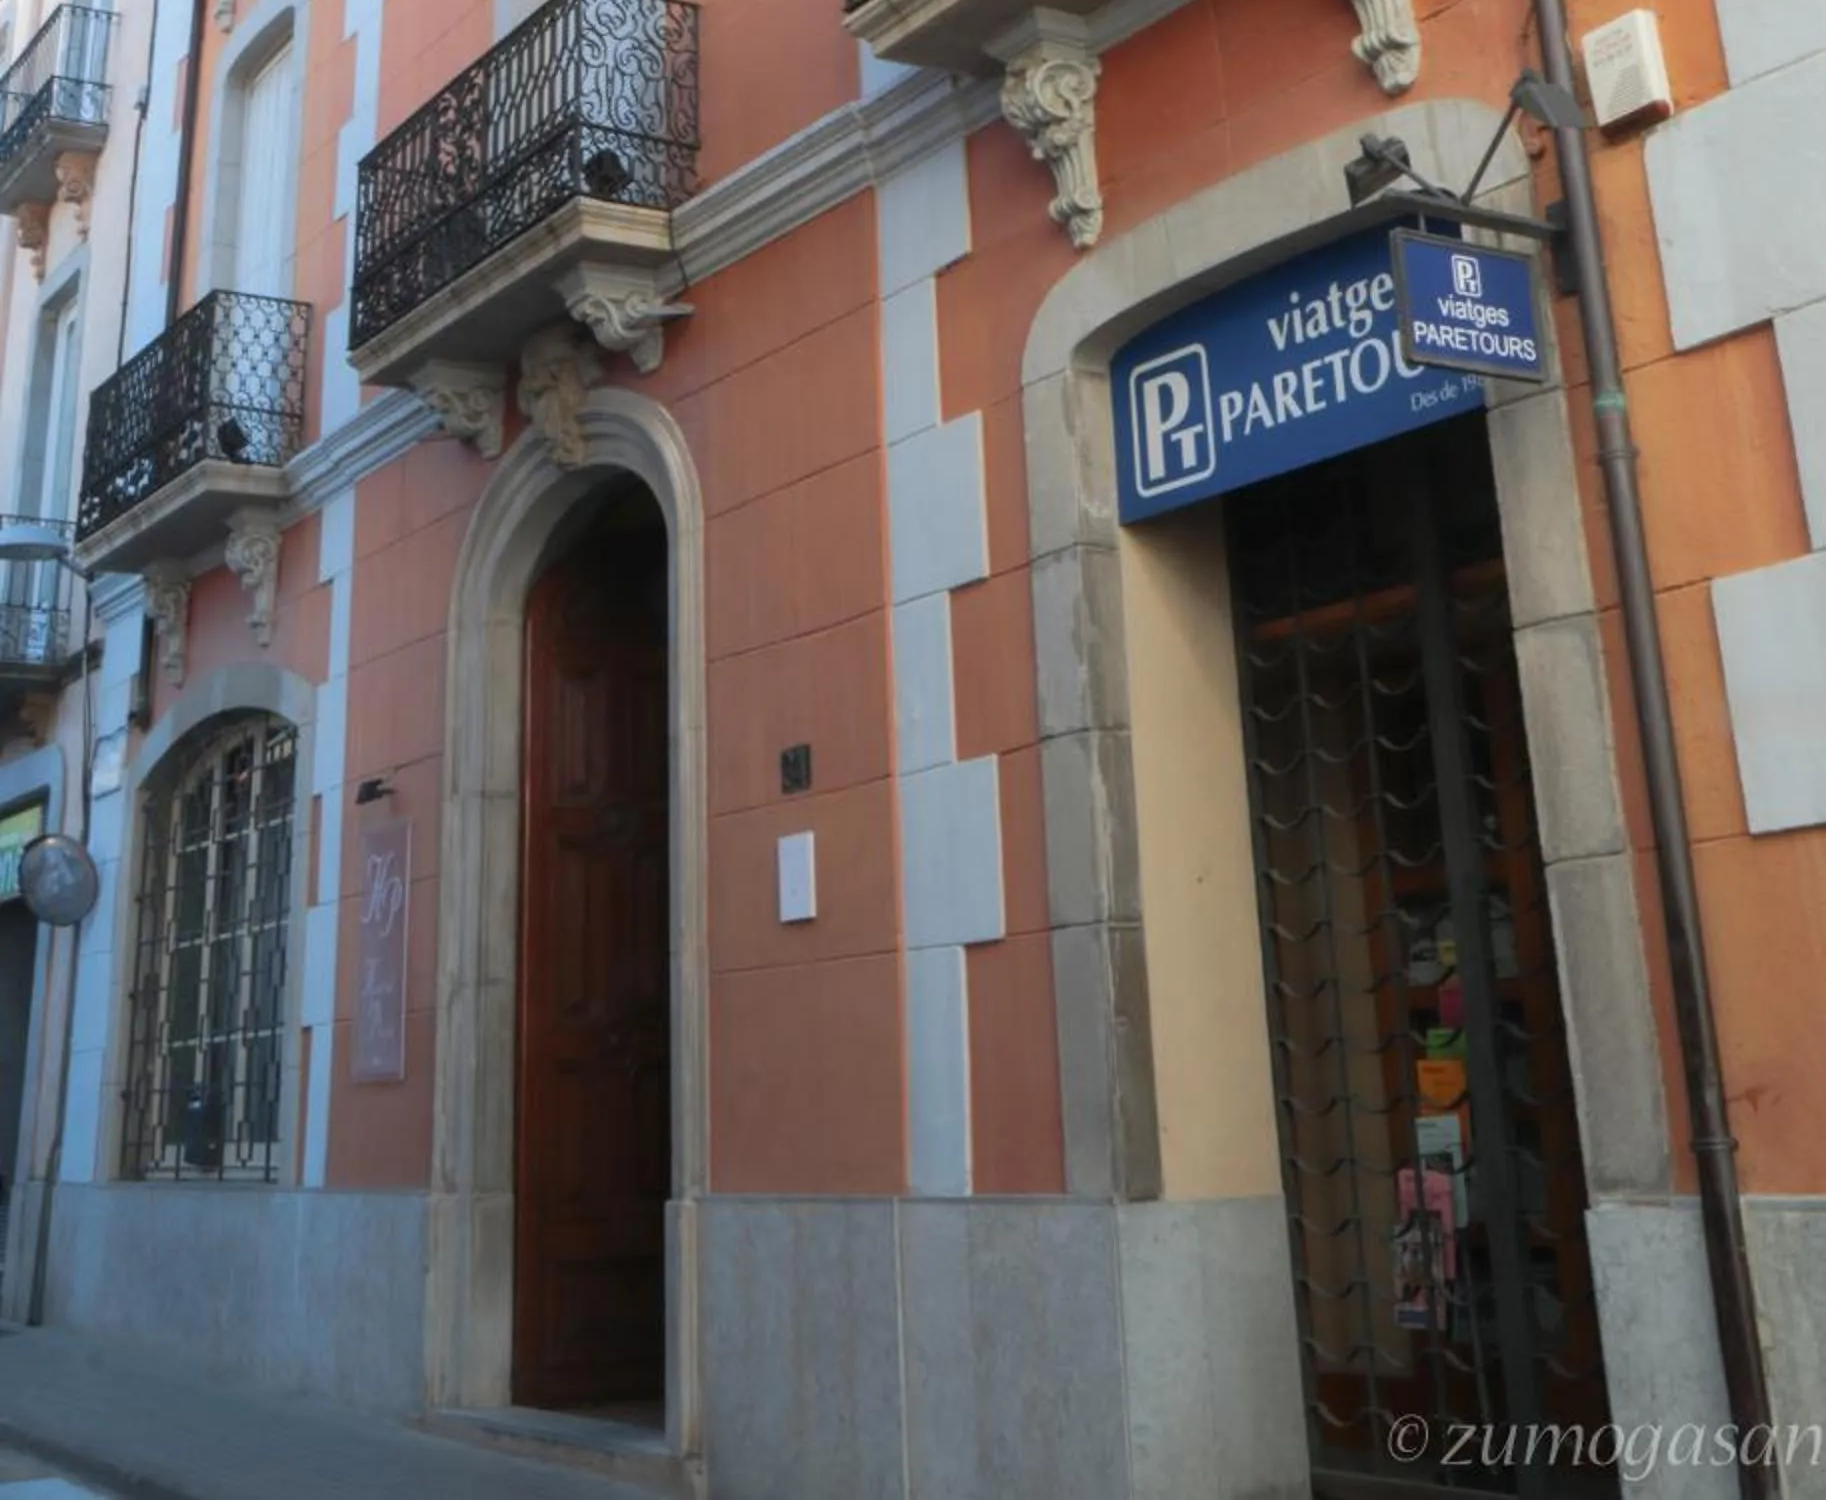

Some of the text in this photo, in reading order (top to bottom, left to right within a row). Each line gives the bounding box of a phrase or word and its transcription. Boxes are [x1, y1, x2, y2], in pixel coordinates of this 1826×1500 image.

[1267, 272, 1395, 351] viatge
[1413, 321, 1537, 362] PARETOURS
[1437, 294, 1510, 329] viatges
[1219, 330, 1425, 443] PARETOU
